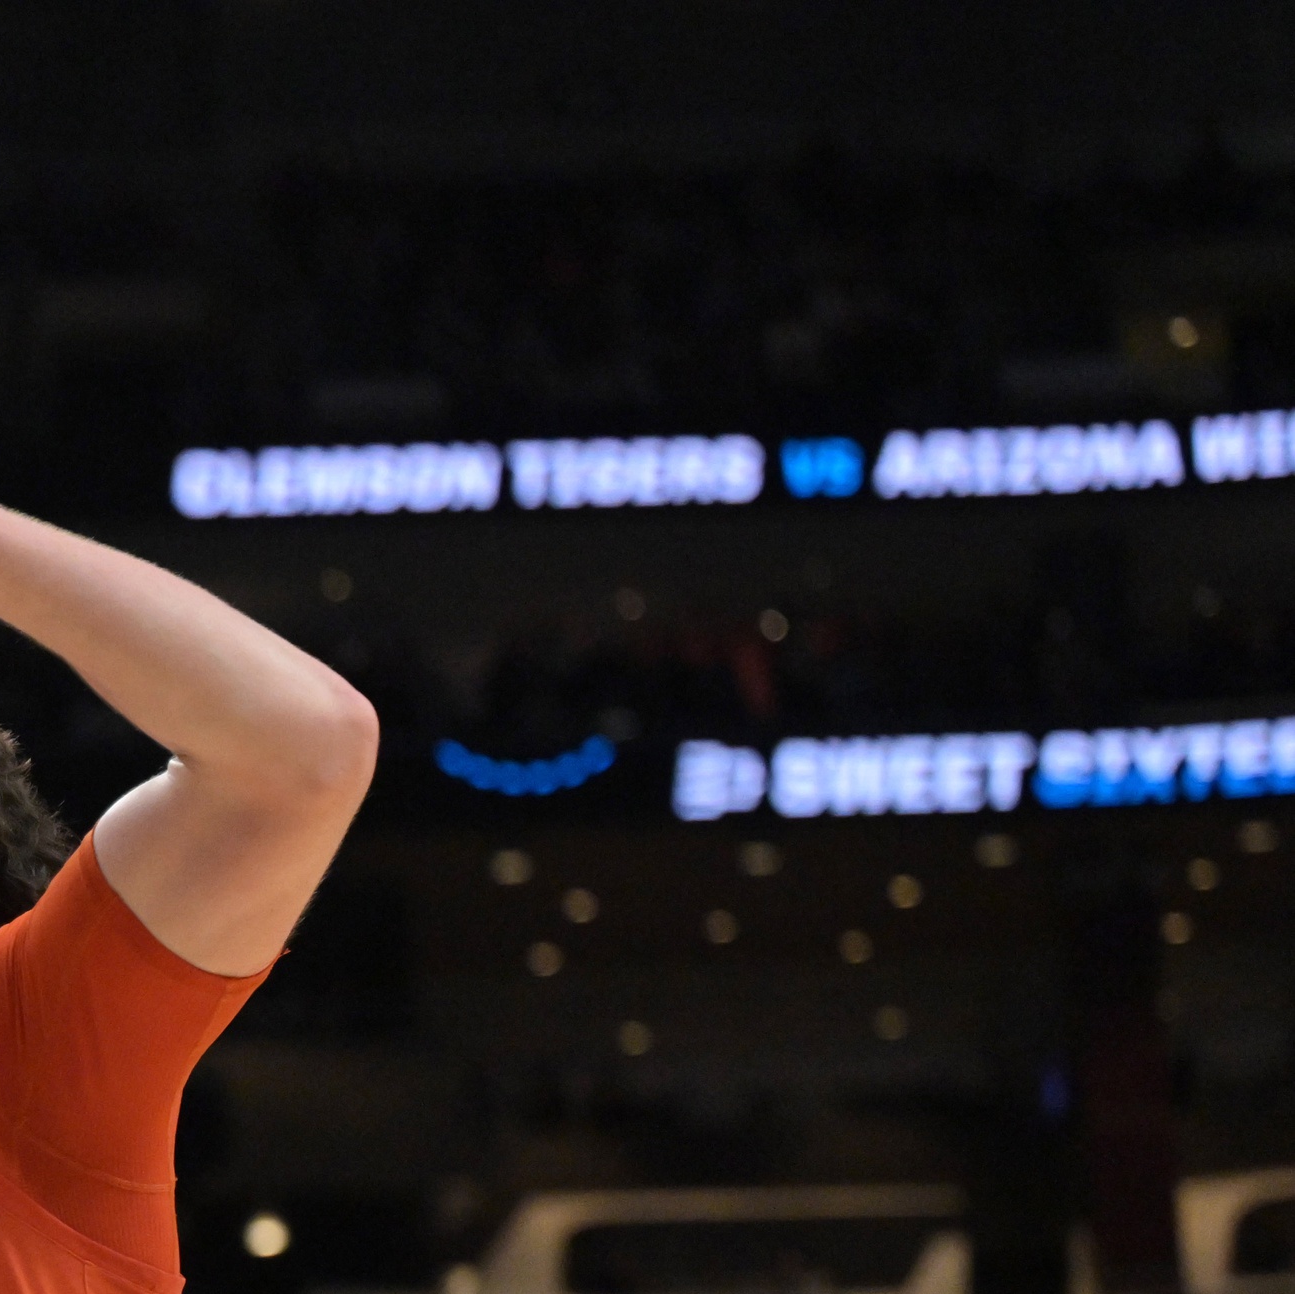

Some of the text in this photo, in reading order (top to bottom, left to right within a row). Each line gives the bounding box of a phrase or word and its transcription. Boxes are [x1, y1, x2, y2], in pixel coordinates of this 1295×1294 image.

[171, 444, 503, 519] CLEMSON
[508, 433, 765, 510] TIGERS
[872, 418, 1185, 500] ARIZONA
[1191, 408, 1295, 484] WI
[770, 732, 1037, 818] SWEET
